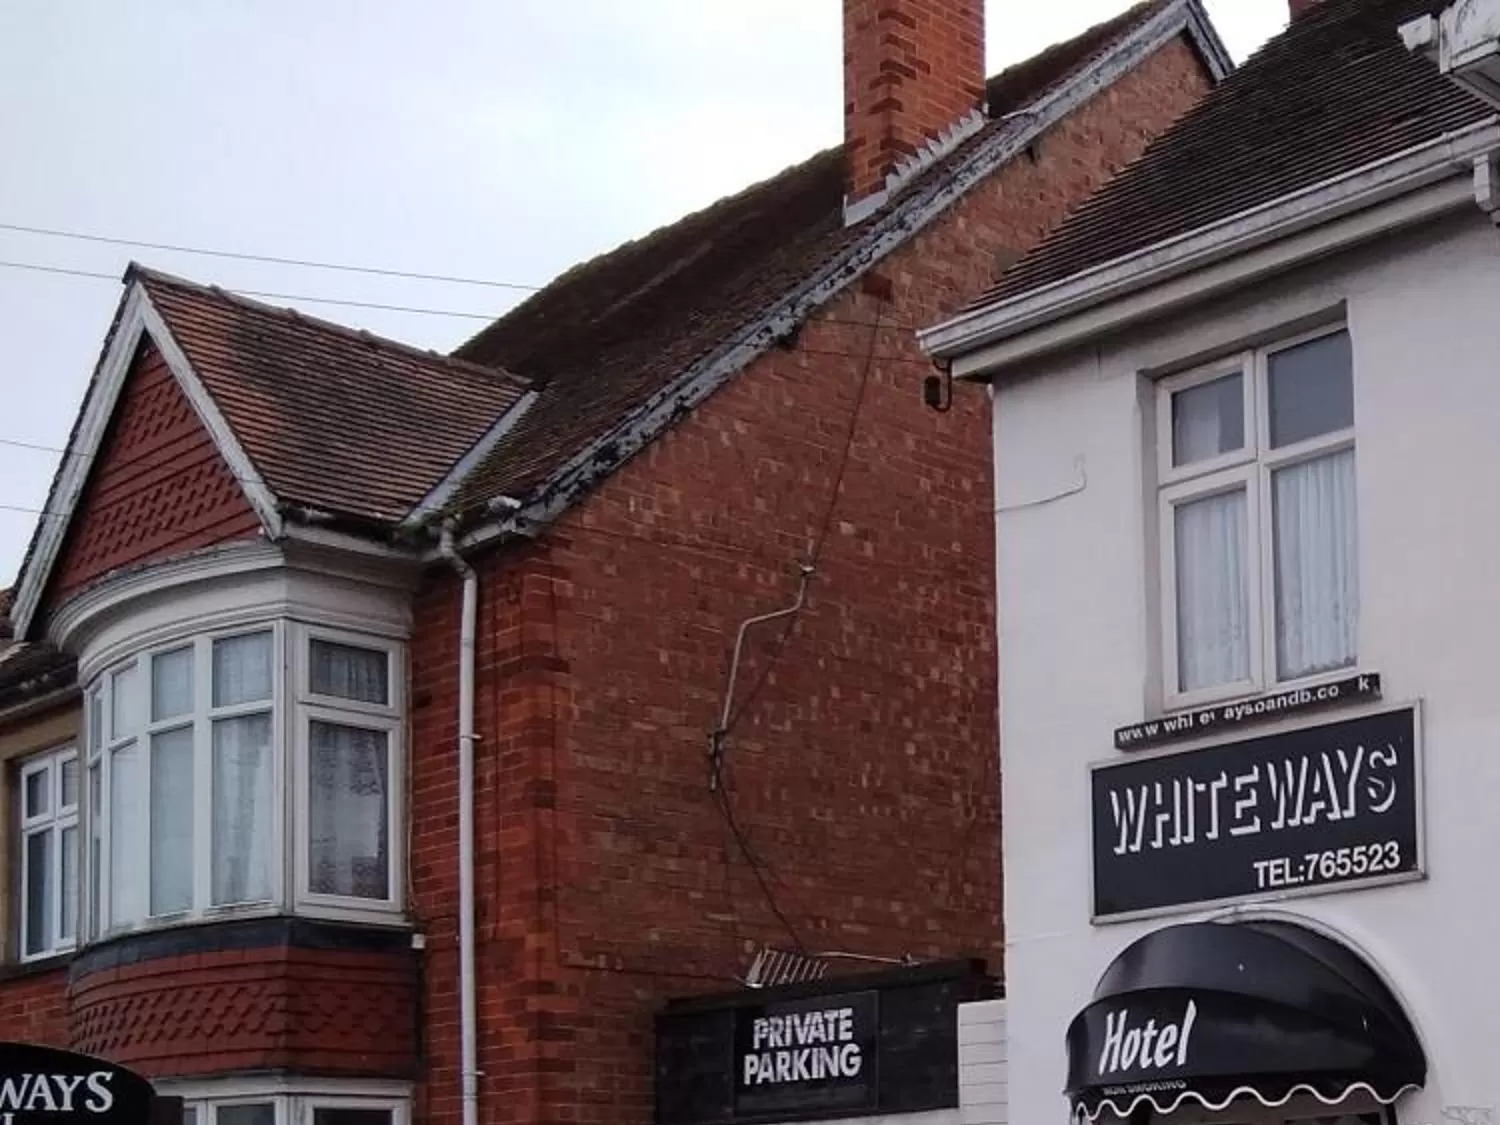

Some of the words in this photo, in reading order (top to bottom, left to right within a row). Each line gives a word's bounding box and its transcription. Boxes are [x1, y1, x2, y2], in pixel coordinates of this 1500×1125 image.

[1110, 743, 1398, 855] WHITEWAYS
[753, 1007, 853, 1049] PRIVATE
[1099, 999, 1197, 1076] Hotel
[744, 1043, 862, 1085] PARKING
